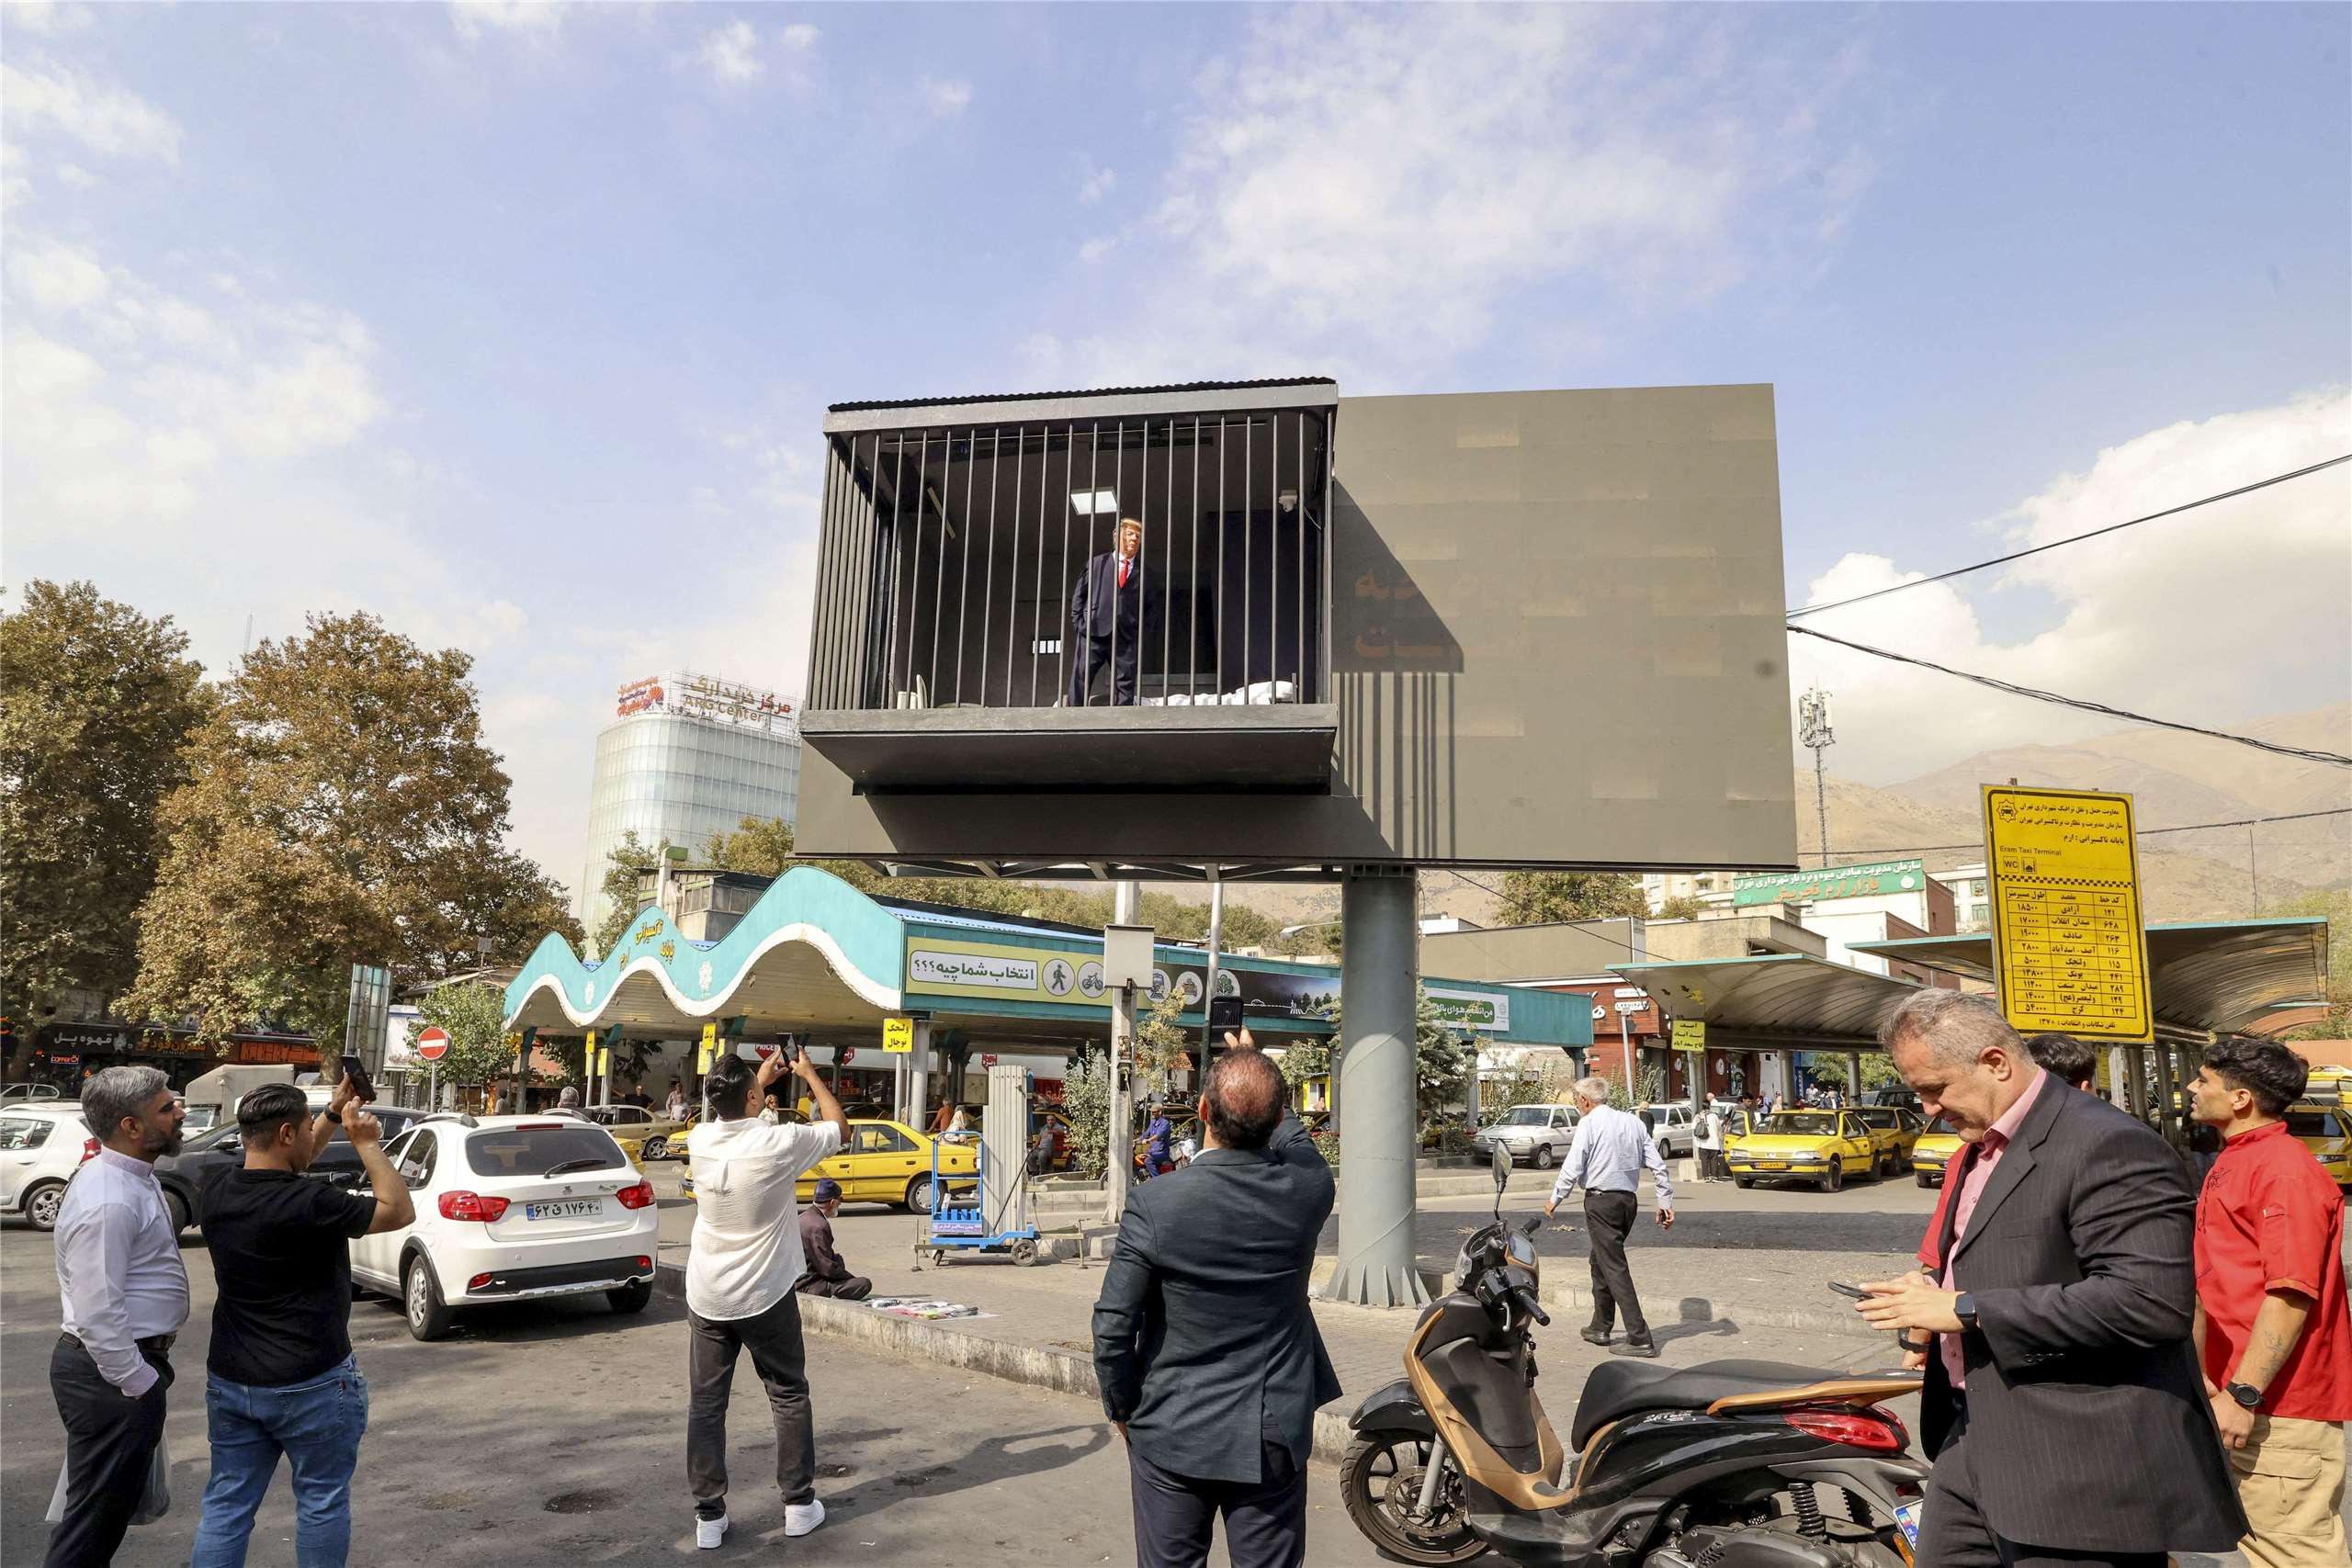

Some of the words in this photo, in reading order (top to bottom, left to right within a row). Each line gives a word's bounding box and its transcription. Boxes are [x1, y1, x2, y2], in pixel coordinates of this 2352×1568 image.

[684, 695, 714, 710] ARG
[718, 700, 763, 722] Center
[2034, 847, 2062, 856] Terminal
[1863, 865, 1892, 876] مدیریت
[1893, 860, 1922, 873] سازمان
[1819, 873, 1836, 882] میوه
[1836, 867, 1861, 880] میادین
[1735, 878, 1755, 889] تهران
[1755, 874, 1790, 889] شهرداری
[1825, 881, 1846, 898] ارم
[2031, 890, 2045, 900] طول
[2018, 903, 2038, 911] ۱۸۵۰۰
[2062, 906, 2080, 914] آزادی
[2025, 956, 2040, 964] ۵۰۰۰
[2065, 957, 2086, 967] ولنجک
[961, 963, 989, 976] شما
[989, 966, 1034, 982] انتخاب
[2080, 983, 2098, 991] میدان
[1447, 1005, 1464, 1016] هوای
[2073, 1006, 2084, 1014] کرج
[888, 1023, 910, 1034] ولنجک
[53, 1032, 77, 1047] پل
[79, 1033, 112, 1045] قهوه
[565, 1202, 584, 1214] ۱۷۶
[588, 1203, 599, 1213] ۴۰
